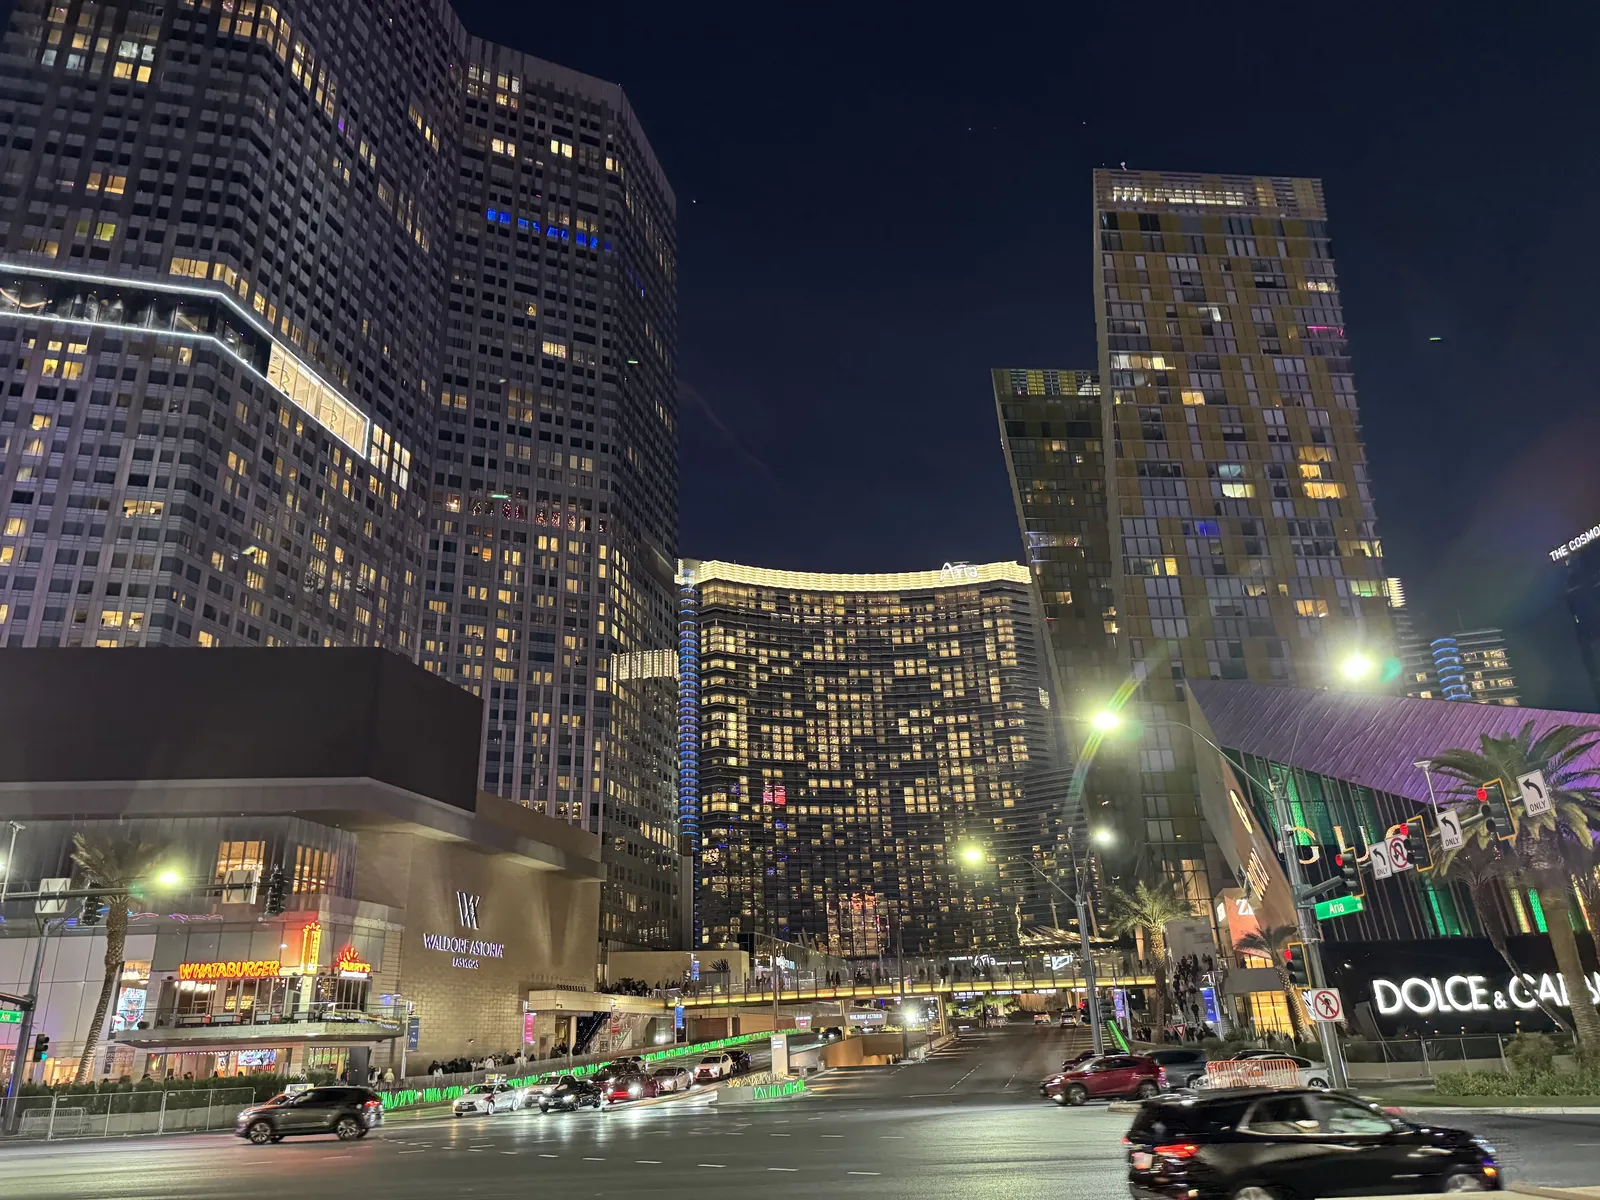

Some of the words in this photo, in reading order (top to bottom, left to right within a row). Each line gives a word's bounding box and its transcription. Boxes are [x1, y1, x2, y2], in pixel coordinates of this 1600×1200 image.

[1549, 544, 1569, 561] THE
[1569, 524, 1600, 550] COSMO
[940, 562, 978, 581] Aria
[1529, 800, 1546, 812] ONLY
[1445, 836, 1460, 847] ONLY
[1376, 868, 1388, 876] ONLY
[1329, 901, 1345, 915] Aria
[423, 932, 470, 954] WALDORF
[469, 940, 503, 958] ASTORIA
[179, 960, 280, 979] WHATABURGER
[339, 961, 371, 973] PARRY'S
[1372, 975, 1490, 1014] DOLCE
[1493, 991, 1508, 1010] &
[1, 1011, 11, 1021] Aria
